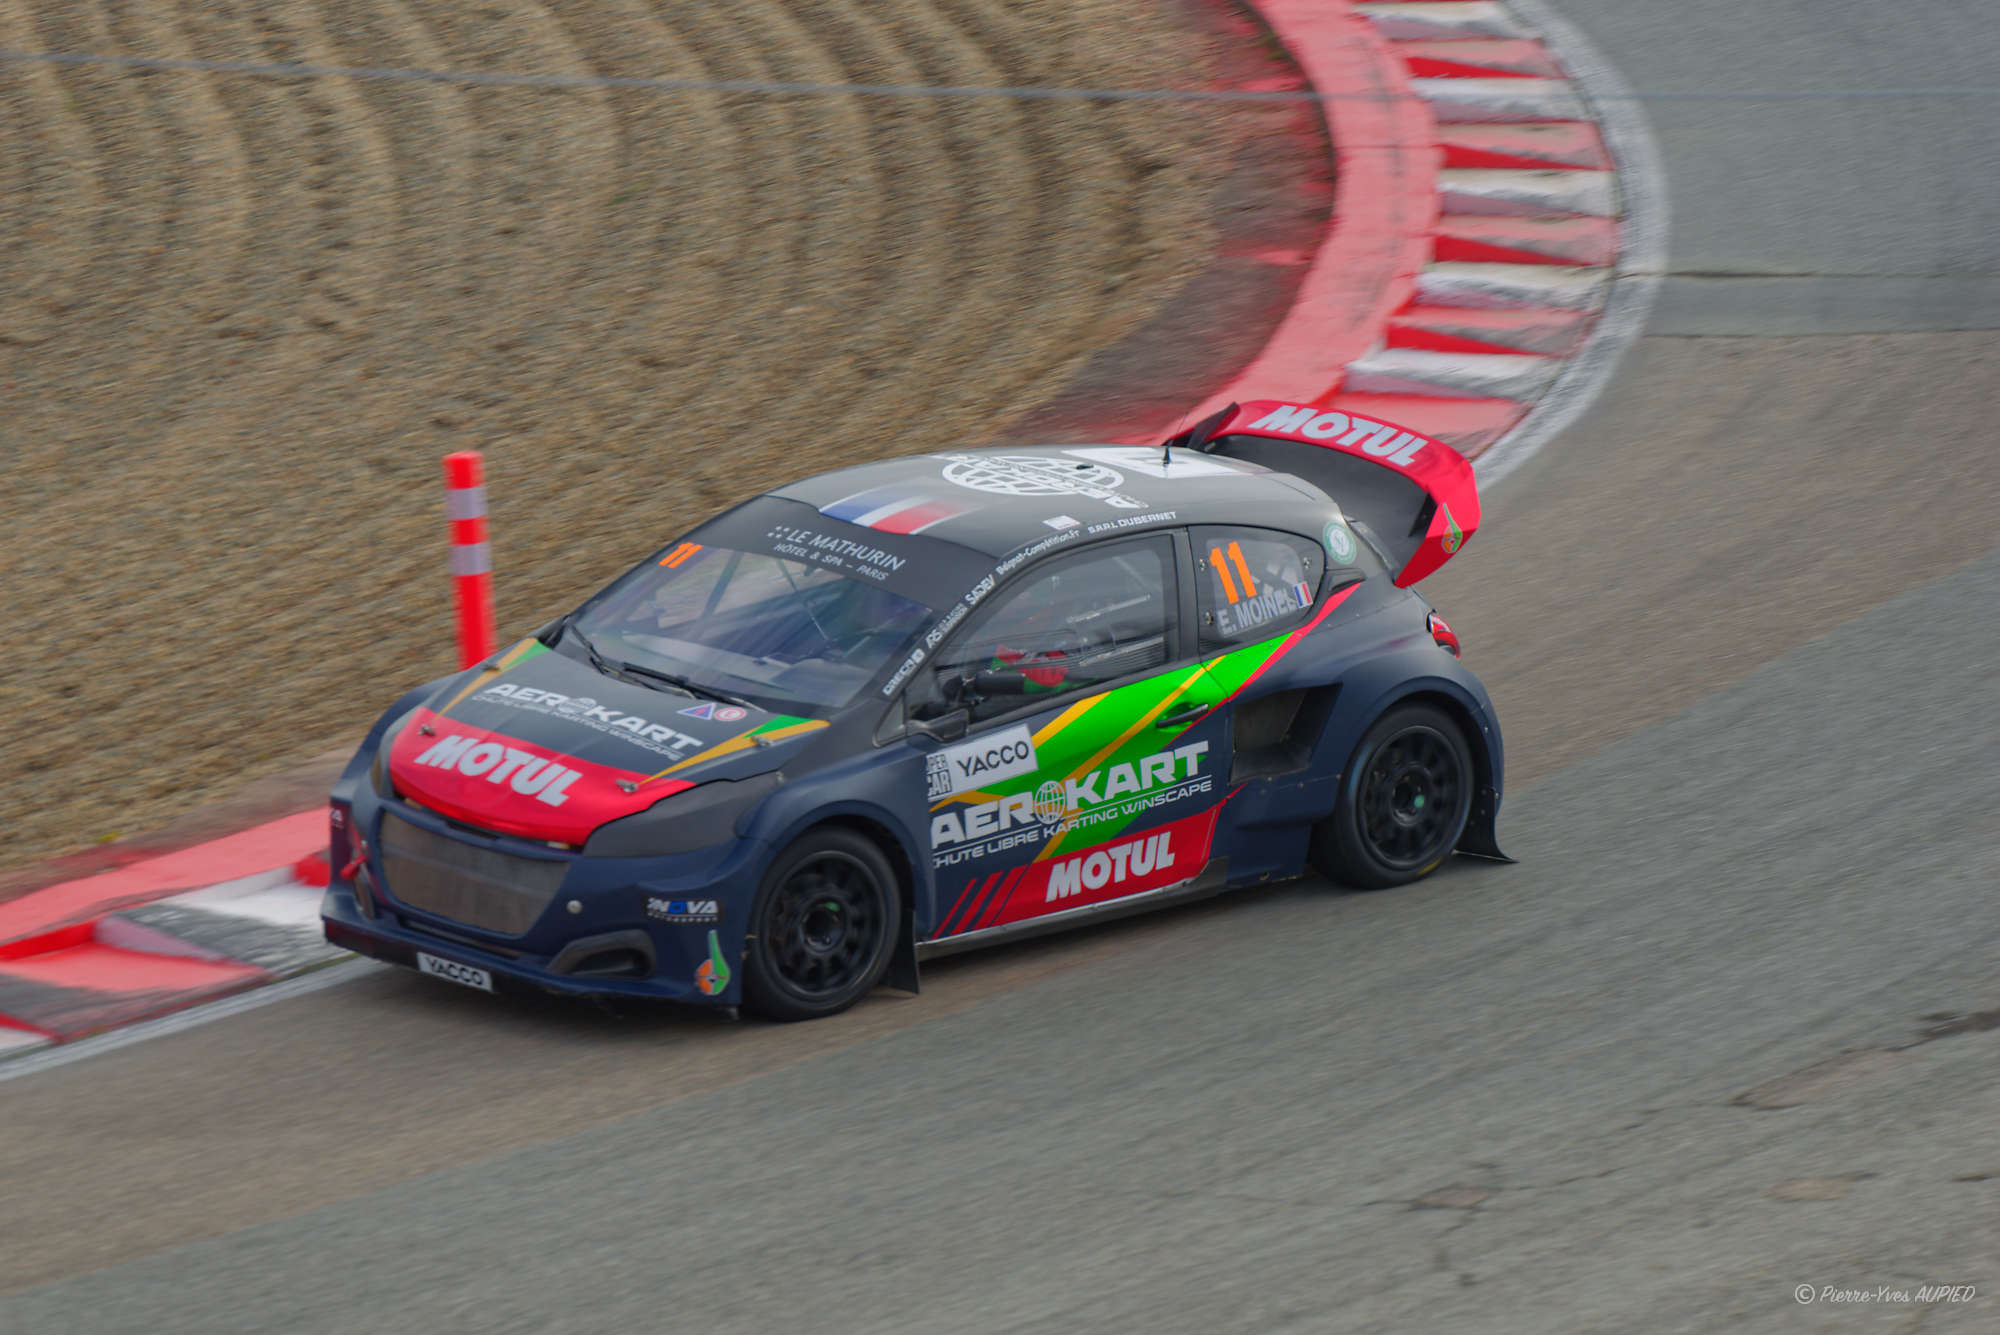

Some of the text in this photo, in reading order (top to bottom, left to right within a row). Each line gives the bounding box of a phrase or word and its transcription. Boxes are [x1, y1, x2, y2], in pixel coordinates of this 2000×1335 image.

[1247, 405, 1429, 466] MOTUL
[1118, 511, 1177, 527] DUBERNET
[659, 542, 703, 569] 11
[786, 530, 906, 571] LE MATHURIN
[809, 551, 818, 560] &
[821, 554, 843, 567] SPA
[856, 565, 889, 581] PARIS
[965, 574, 996, 606] SADEV
[1209, 541, 1257, 605] 11
[1217, 608, 1237, 636] E.
[413, 735, 583, 807] MOTUL
[957, 741, 1030, 777] YACCO
[987, 829, 1039, 854] LIBRE
[1043, 807, 1118, 838] KARTING
[1120, 780, 1212, 815] WINSCAPE
[1046, 831, 1175, 903] MOTUL
[424, 957, 484, 985] YACCO
